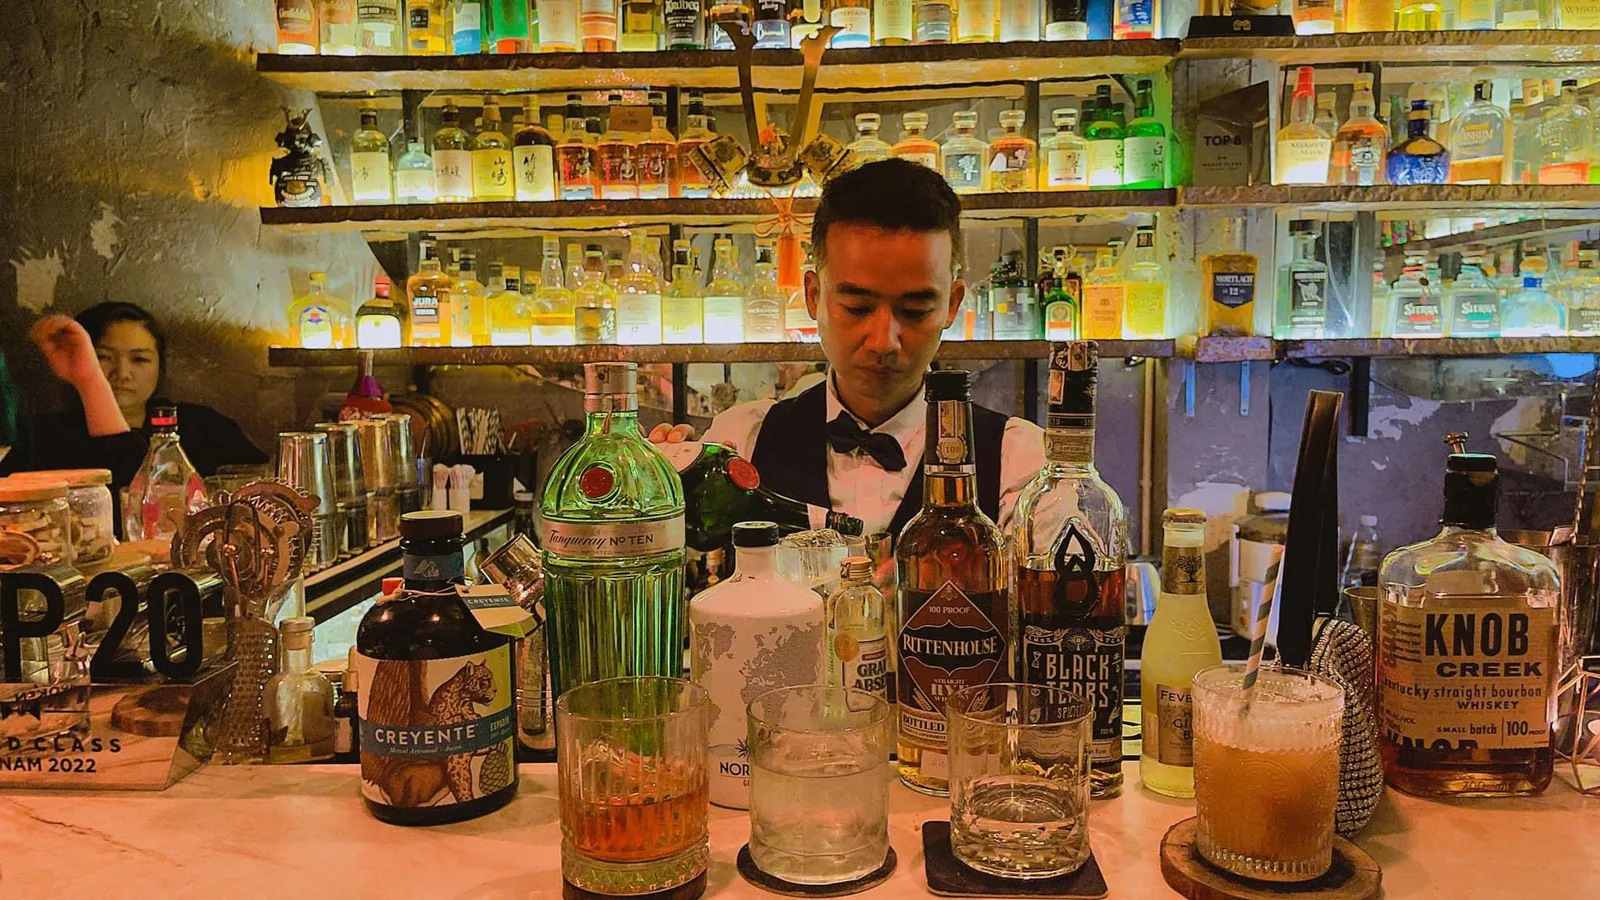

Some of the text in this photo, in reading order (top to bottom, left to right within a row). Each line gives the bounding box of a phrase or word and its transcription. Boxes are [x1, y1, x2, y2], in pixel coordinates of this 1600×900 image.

[1203, 135, 1231, 146] TOP
[413, 297, 438, 306] JURA
[1404, 303, 1438, 315] SIERRA
[1461, 302, 1496, 314] SIERRA
[550, 529, 606, 549] Tanqueray
[628, 534, 654, 546] TEN
[943, 606, 972, 614] PROOF
[86, 571, 204, 684] 20
[1426, 613, 1529, 656] KNOB
[903, 633, 998, 657] RITTENHOUSE
[1046, 653, 1109, 680] BLACK
[1436, 662, 1542, 677] CREEK
[1046, 681, 1109, 708] TEARS
[1433, 684, 1487, 701] straight
[1491, 682, 1542, 698] bourbon
[1457, 701, 1519, 710] WHISKEY
[903, 713, 946, 732] BOTTLED
[1469, 723, 1497, 735] batch
[1506, 721, 1529, 736] 100
[375, 724, 477, 745] CREYENTE
[34, 736, 121, 753] CLASS
[48, 758, 97, 773] 2022
